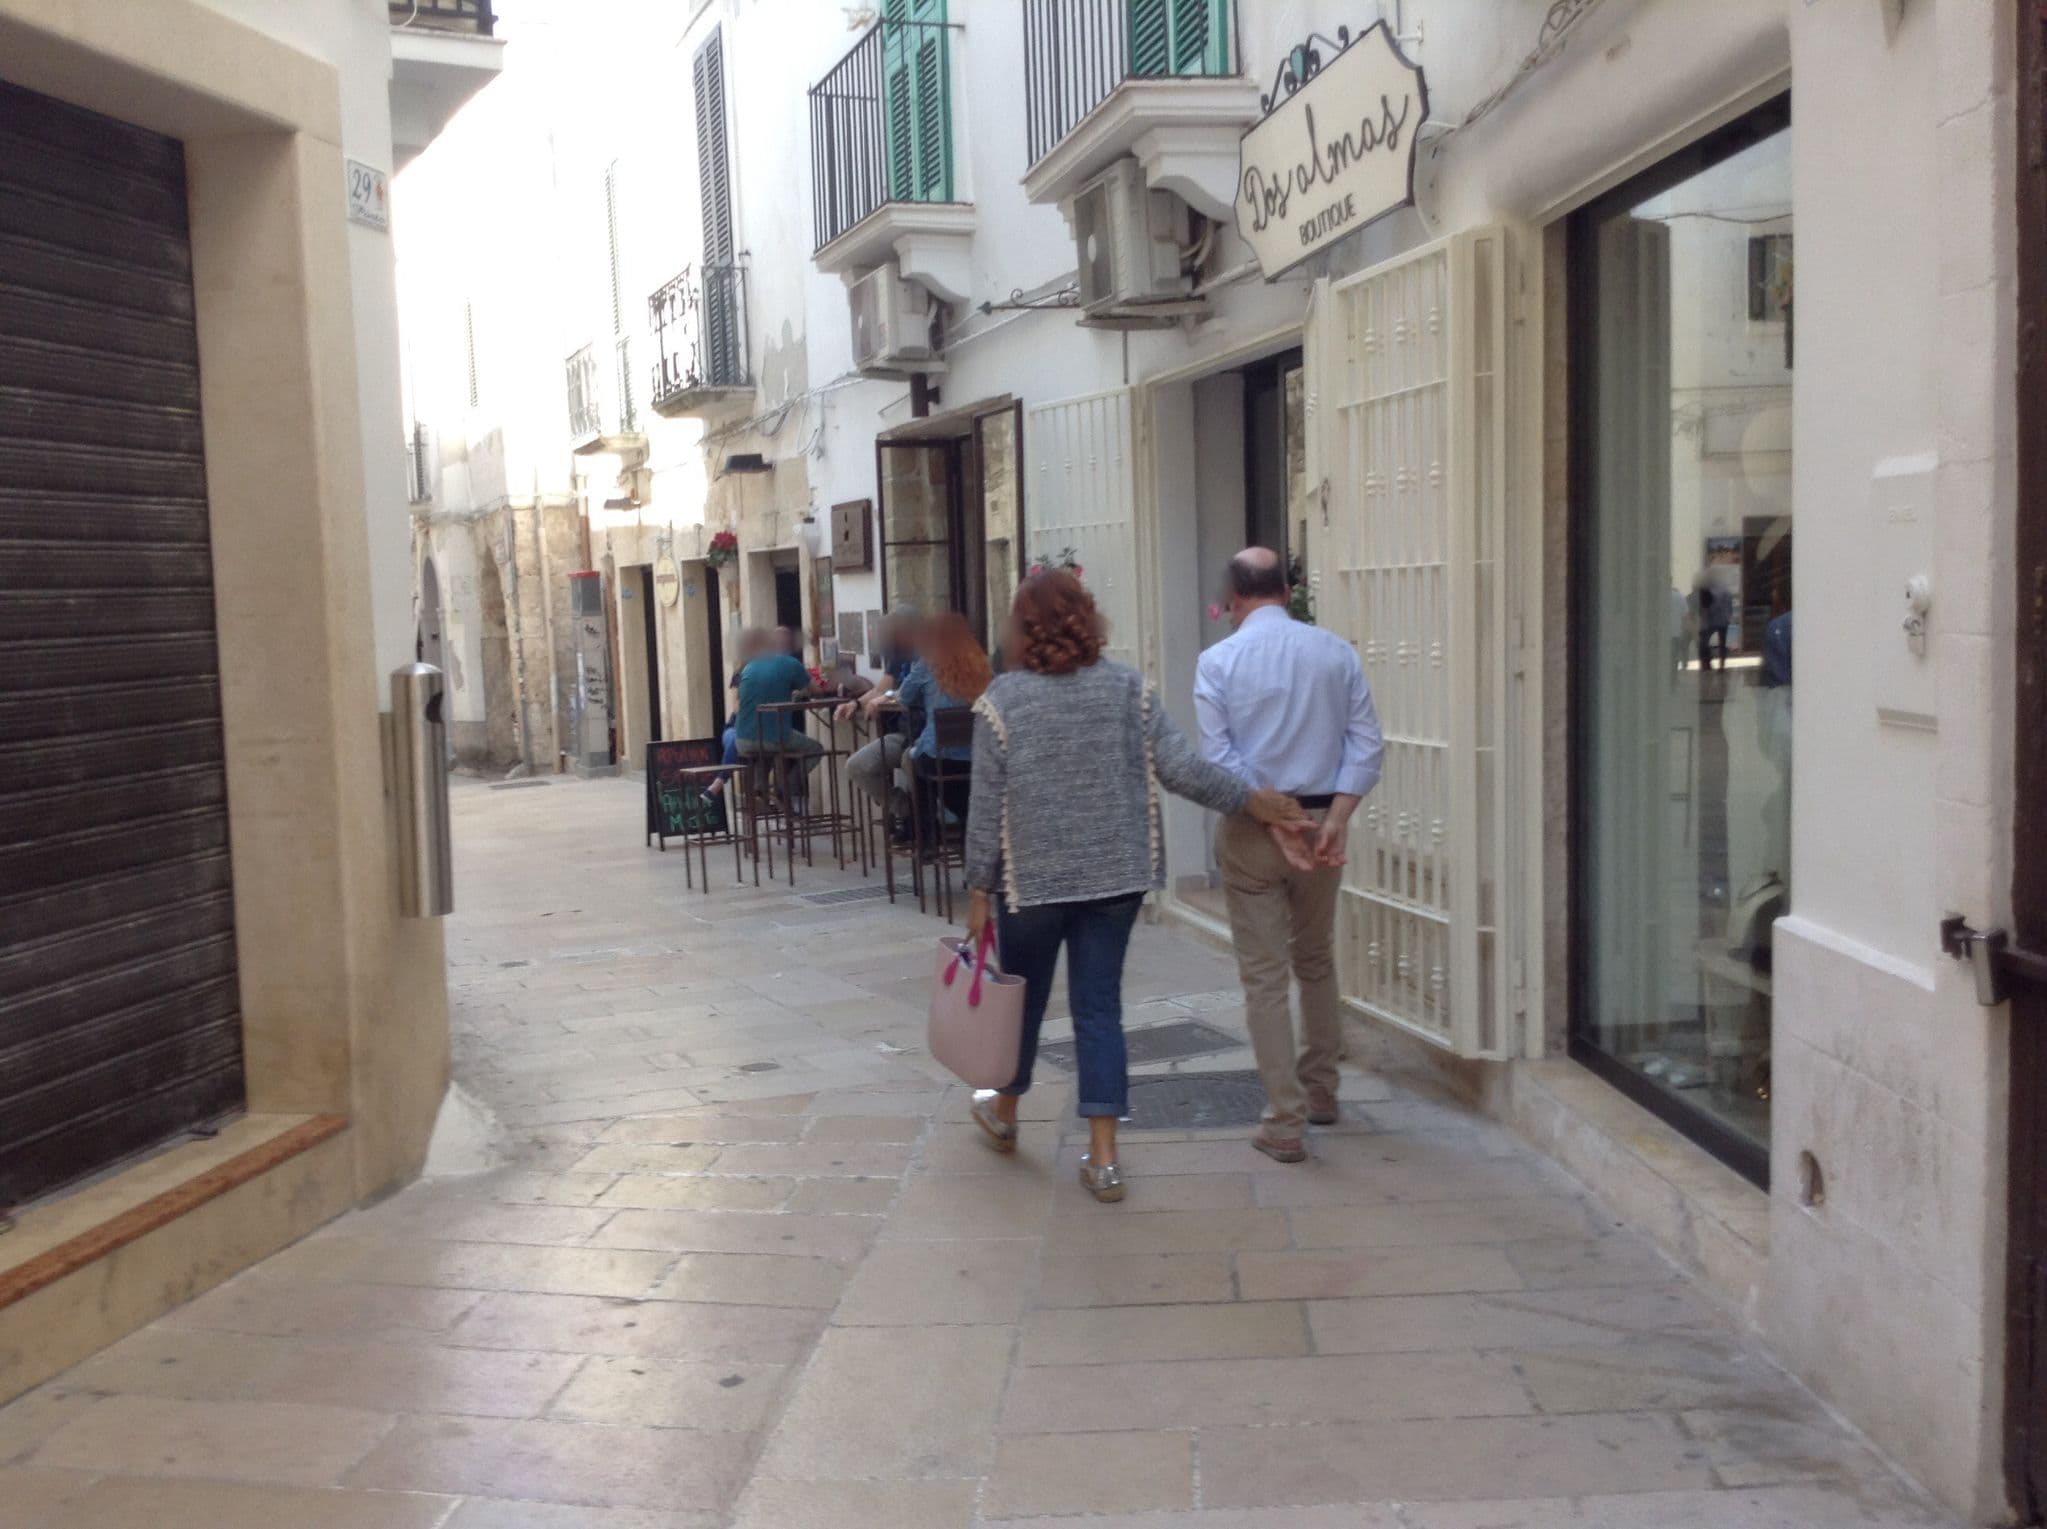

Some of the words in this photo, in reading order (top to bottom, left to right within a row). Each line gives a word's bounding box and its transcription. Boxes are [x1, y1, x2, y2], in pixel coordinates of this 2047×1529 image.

[352, 169, 371, 203] 29
[1244, 166, 1292, 232] Dos
[1297, 95, 1409, 194] almas
[1299, 194, 1356, 245] BOUTIQUE
